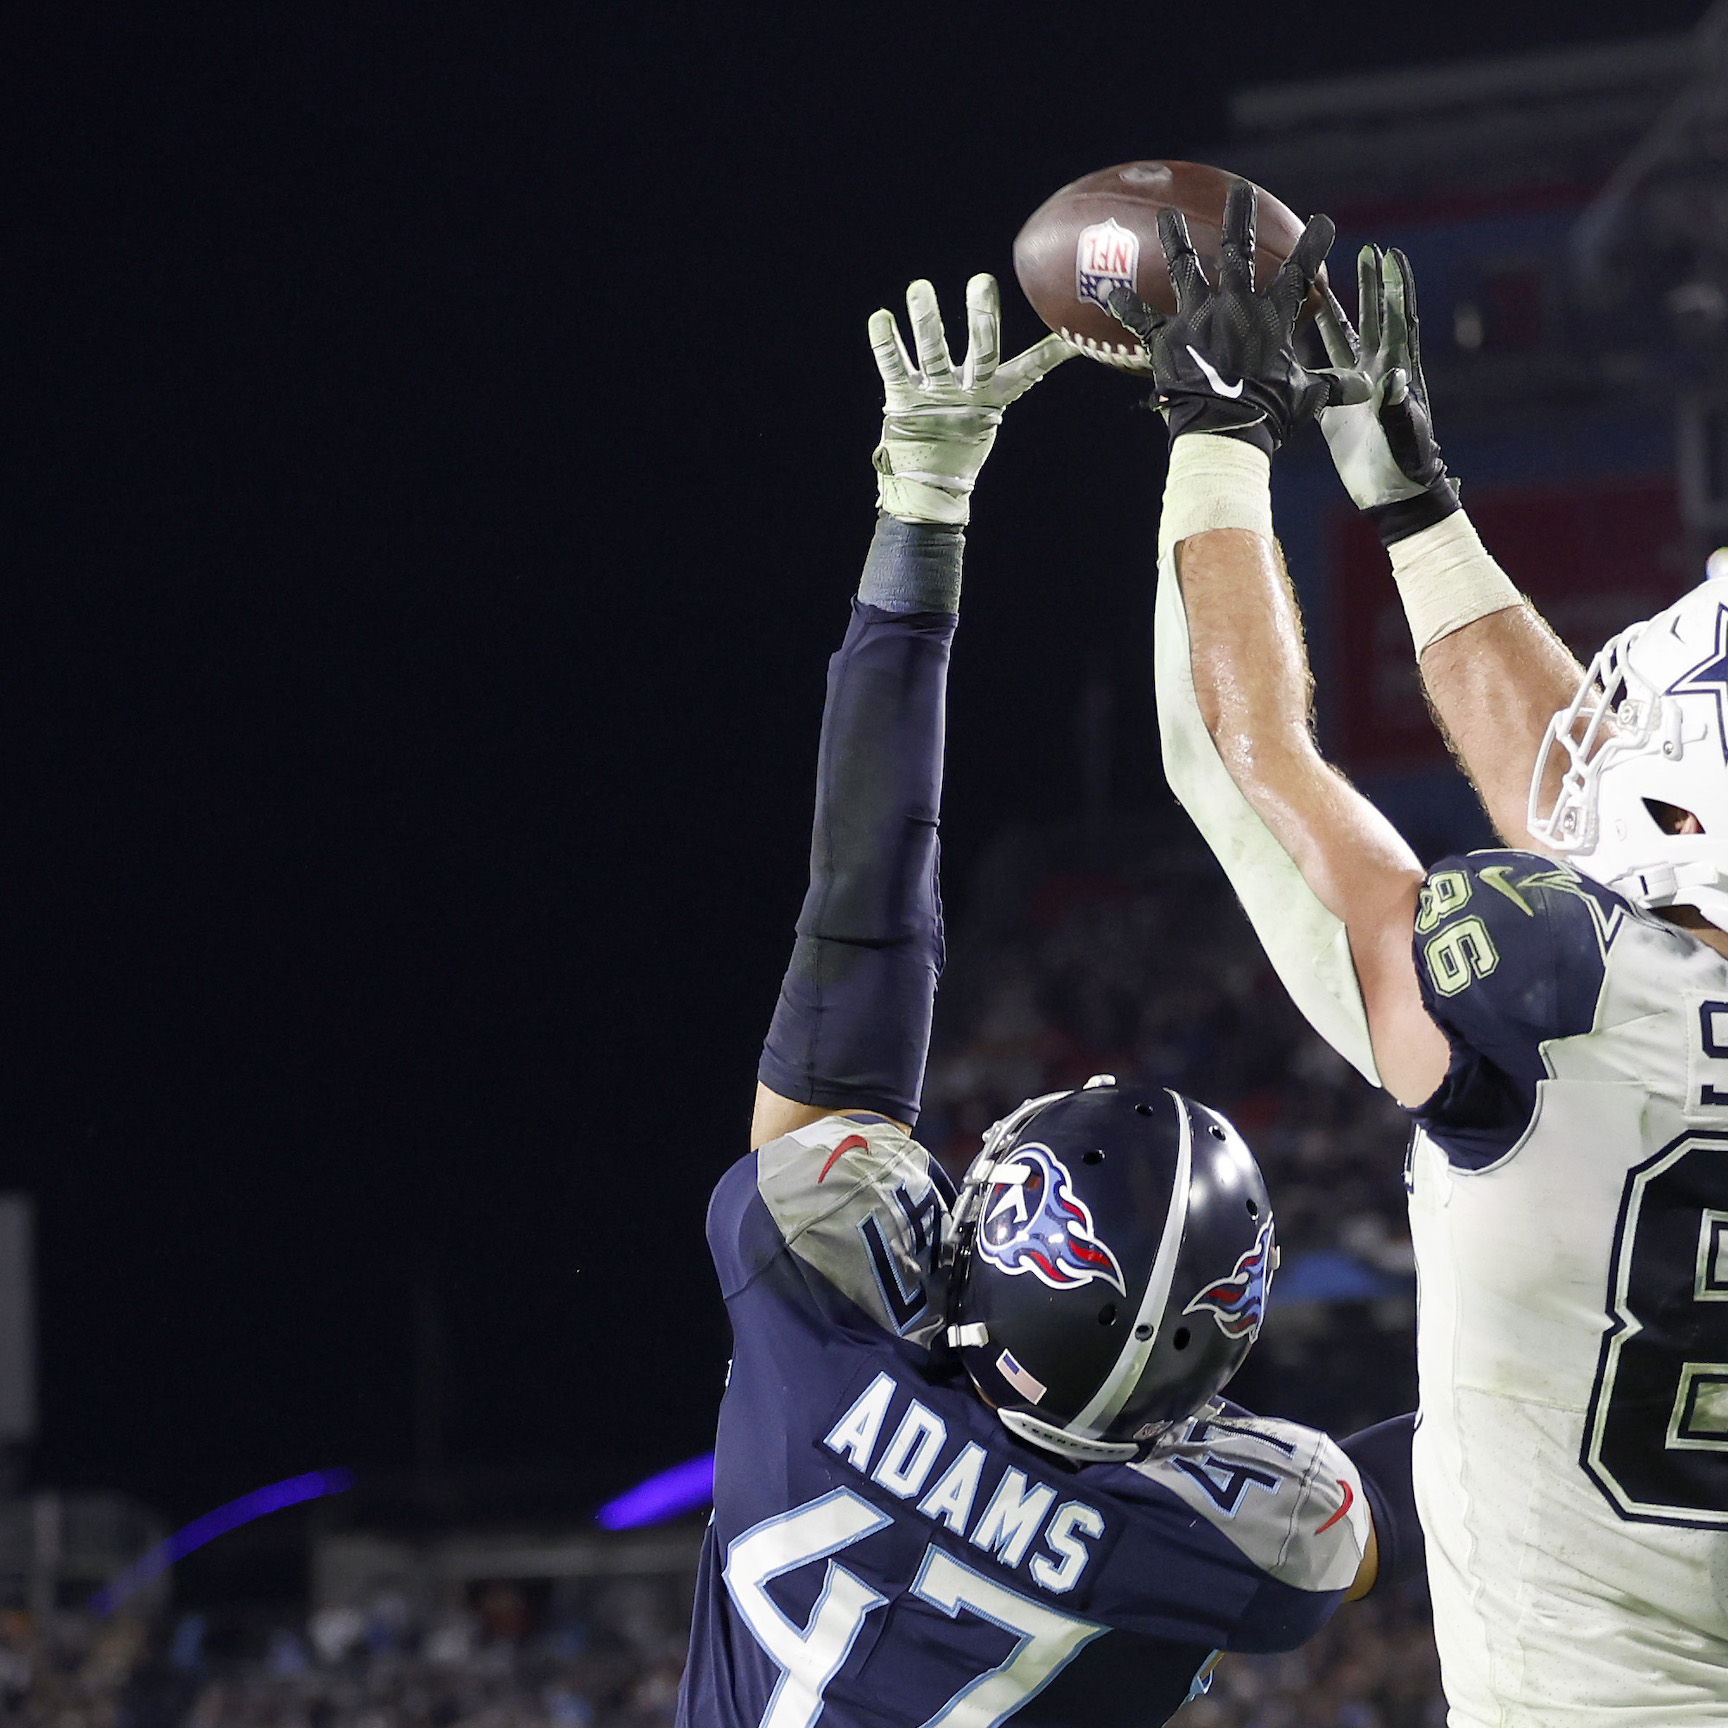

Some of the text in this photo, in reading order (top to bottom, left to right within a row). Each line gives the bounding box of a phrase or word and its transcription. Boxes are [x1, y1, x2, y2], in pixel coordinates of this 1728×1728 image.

[1089, 234, 1130, 273] NFL
[1415, 870, 1500, 998] 86
[823, 1371, 1103, 1595] ADAMS
[1166, 1416, 1298, 1519] 47
